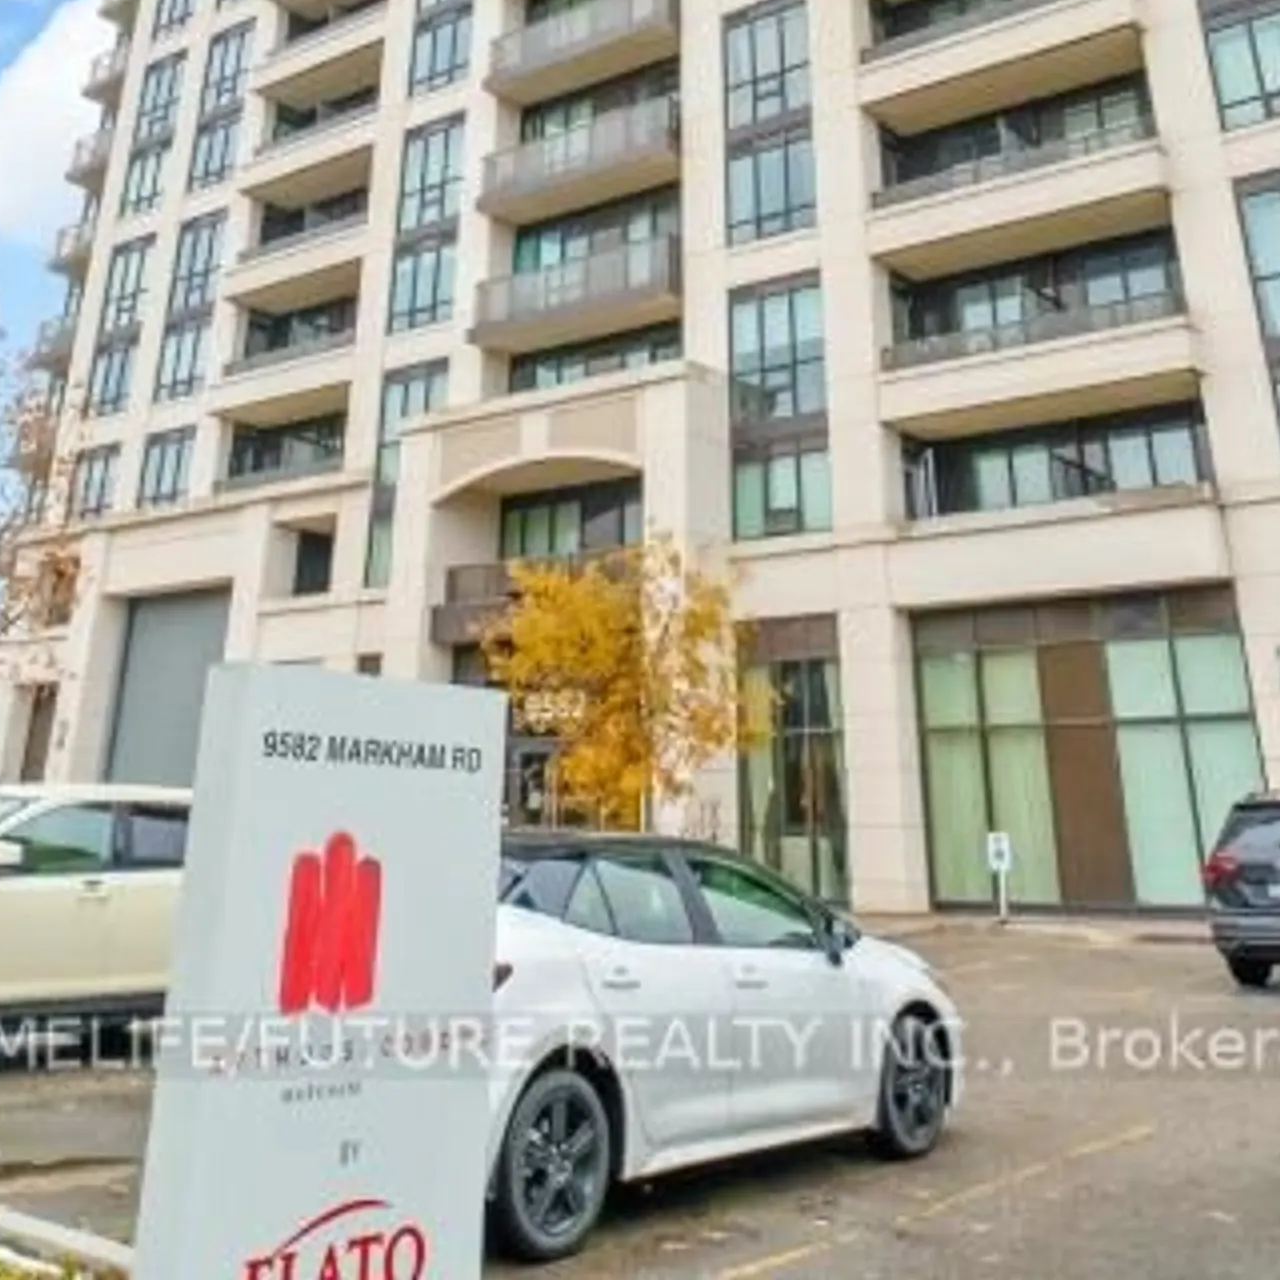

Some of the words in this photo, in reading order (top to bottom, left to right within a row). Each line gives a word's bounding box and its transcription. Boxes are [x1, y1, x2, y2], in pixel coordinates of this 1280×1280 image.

[263, 730, 320, 762] 9582
[326, 735, 446, 769] MARKHAM
[451, 746, 482, 774] RD
